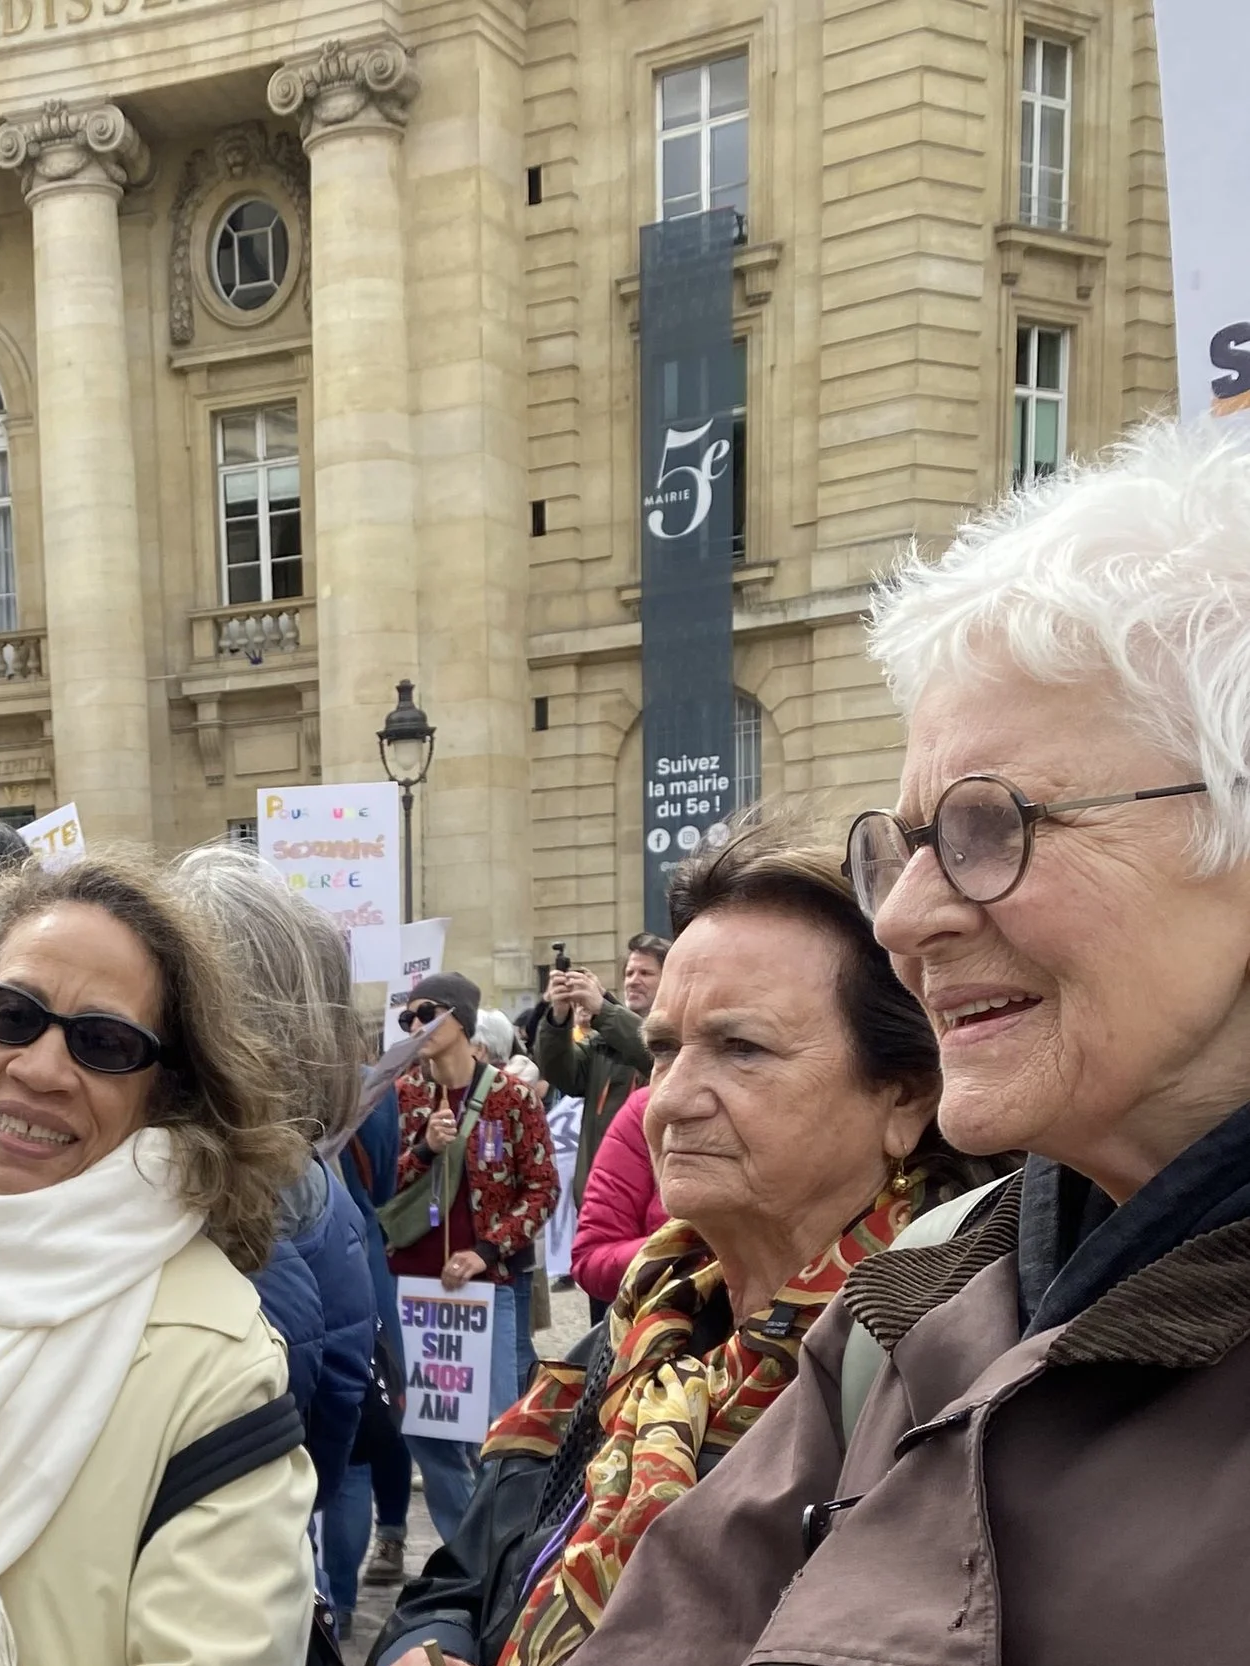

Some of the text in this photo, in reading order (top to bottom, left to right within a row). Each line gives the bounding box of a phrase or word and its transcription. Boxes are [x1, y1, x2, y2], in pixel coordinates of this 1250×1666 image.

[643, 417, 730, 539] MAIRIE 5e
[657, 754, 720, 775] Suivez
[648, 773, 730, 797] la mairie
[656, 800, 682, 818] du
[686, 797, 710, 815] 5e
[401, 1300, 488, 1332] CHOICE
[422, 1332, 462, 1362] HIS
[409, 1362, 474, 1394] BODY
[418, 1393, 460, 1423] MY
